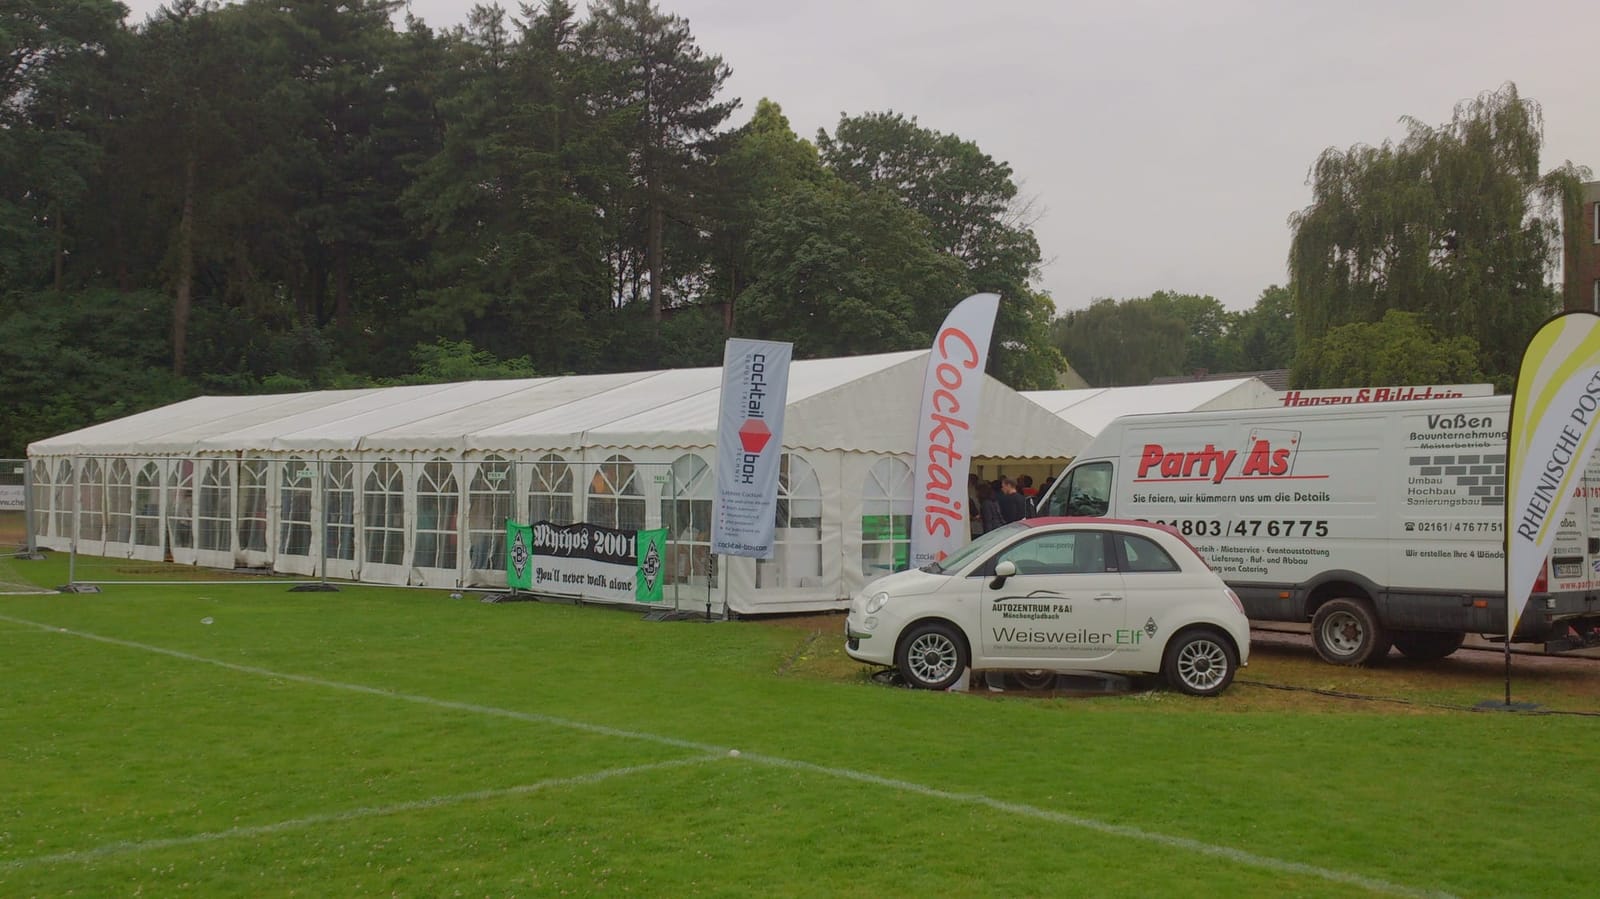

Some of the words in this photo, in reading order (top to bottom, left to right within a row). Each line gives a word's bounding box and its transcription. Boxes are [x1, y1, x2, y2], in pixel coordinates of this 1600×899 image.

[748, 353, 767, 418] cocktail
[1279, 391, 1352, 407] Hansen
[1355, 388, 1371, 403] &
[1427, 414, 1493, 429] Vaßen
[925, 327, 979, 538] Cocktails
[1410, 431, 1509, 441] Bauunternehmung
[742, 454, 760, 484] box
[1137, 444, 1237, 484] Party
[1241, 440, 1291, 476] As
[1408, 477, 1443, 485] Umbau
[1517, 425, 1581, 542] RHEINISCHE
[1133, 493, 1147, 503] Sie
[1148, 494, 1177, 505] feiern,
[1179, 494, 1193, 503] wir
[1195, 493, 1237, 503] kümmern
[1239, 495, 1255, 503] uns
[1257, 495, 1272, 503] um
[1274, 492, 1291, 502] die
[1294, 491, 1330, 502] Details
[1407, 488, 1456, 496] Hochbau
[1407, 498, 1480, 507] Sanierungsbau
[1156, 520, 1329, 537] 1803/476775
[533, 524, 589, 555] Mythos
[593, 532, 637, 558] 2001
[1211, 555, 1244, 564] Lieferung
[1282, 557, 1308, 565] Abbau
[1406, 549, 1418, 557] Wir
[1420, 550, 1452, 558] erstellen
[1238, 566, 1268, 574] Catering
[536, 567, 560, 584] You'll
[562, 572, 585, 584] never
[609, 578, 633, 591] alone
[992, 604, 1050, 612] AUTOZENTRUM
[992, 627, 1112, 644] Weisweiler
[1116, 629, 1144, 645] Elf
